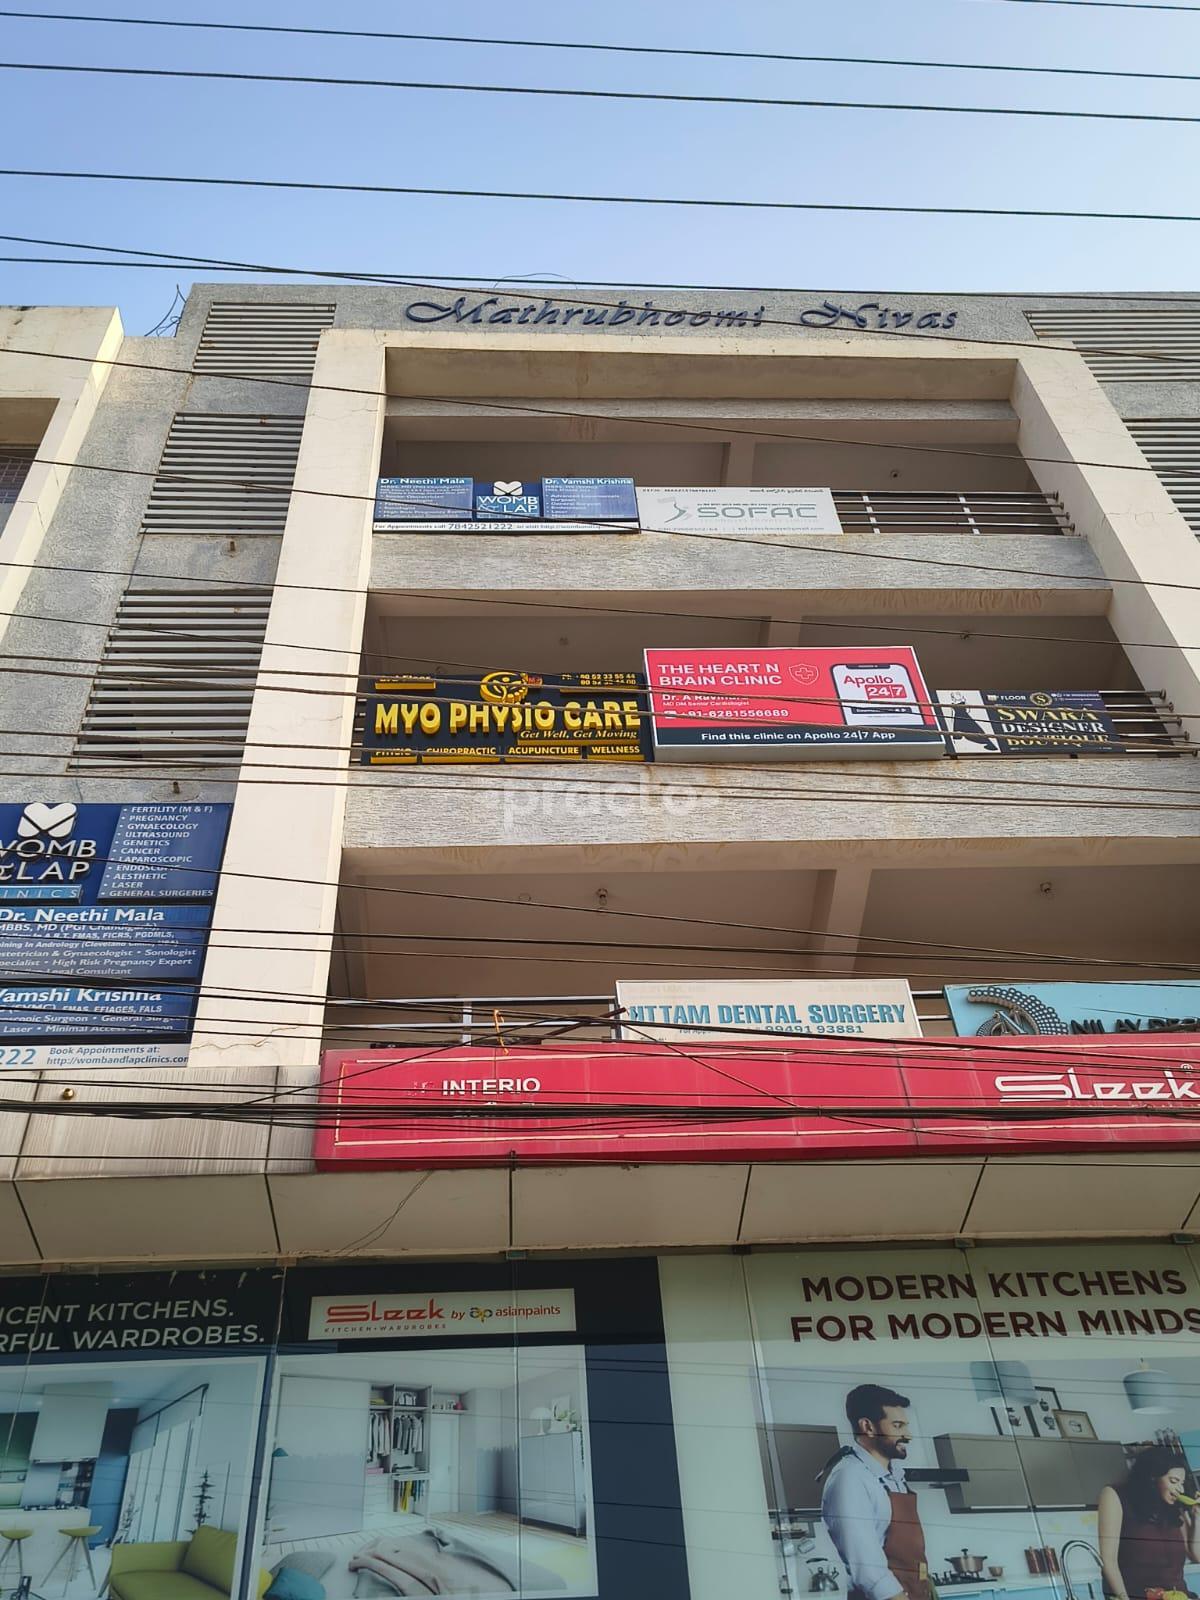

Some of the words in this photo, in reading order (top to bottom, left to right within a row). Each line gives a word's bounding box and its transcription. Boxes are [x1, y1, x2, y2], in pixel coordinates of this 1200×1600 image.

[405, 297, 764, 328] Mathrubhoomi
[800, 300, 958, 330] Nivas
[478, 496, 539, 506] WOMB
[503, 504, 538, 513] LAP
[697, 507, 818, 519] SOFAC
[658, 664, 695, 674] THE
[699, 664, 761, 674] HEART
[766, 663, 780, 673] N
[660, 676, 716, 686] BRAIN
[721, 676, 782, 686] CLINIC
[844, 675, 894, 688] Apollo
[376, 703, 441, 733] MYO
[449, 702, 554, 733] PHYSIO
[563, 701, 642, 731] CARE
[521, 730, 540, 738] Get
[543, 730, 569, 740] Well,
[573, 730, 592, 738] Get
[595, 730, 638, 740] Moving
[702, 733, 725, 741] Find
[729, 732, 751, 741] this
[753, 732, 785, 741] clinic
[805, 732, 842, 743] Apollo
[873, 731, 896, 743] App
[592, 745, 640, 754] WELLNESS
[132, 806, 177, 814] FERTILITY
[123, 839, 171, 847] GENETICS
[16, 861, 90, 880] LAP
[109, 890, 155, 898] GENERAL
[159, 889, 214, 897] SURGERIES
[0, 909, 25, 921] Dr.
[35, 909, 109, 922] Neethi
[115, 909, 165, 921] Mala
[35, 941, 80, 949] Andrology
[63, 949, 134, 958] Gynaecologist
[145, 949, 197, 957] Sonologist
[53, 958, 76, 967] High
[80, 958, 101, 966] Risk
[103, 958, 156, 967] Pregnancy
[159, 958, 193, 967] Expert
[76, 968, 132, 976] Consultant
[44, 1014, 88, 1024] Surgeon
[718, 1004, 802, 1024] DENTAL
[808, 1003, 905, 1024] SURGERY
[45, 1025, 87, 1033] Minimal
[816, 1025, 863, 1034] 93881
[50, 1047, 73, 1055] Book
[75, 1046, 144, 1057] Appointments
[442, 1078, 541, 1095] INTERIO
[995, 1067, 1200, 1102] Sleek
[802, 1274, 977, 1302] MODERN
[988, 1269, 1187, 1298] KITCHENS
[88, 1298, 234, 1321] KITCHENS.
[326, 1298, 445, 1323] Sleek
[451, 1310, 466, 1321] by
[495, 1306, 561, 1319] asianpaints
[791, 1314, 876, 1342] FOR
[888, 1310, 1067, 1340] MODERN
[1077, 1305, 1200, 1336] MINDS
[73, 1325, 264, 1350] WARDROBES.
